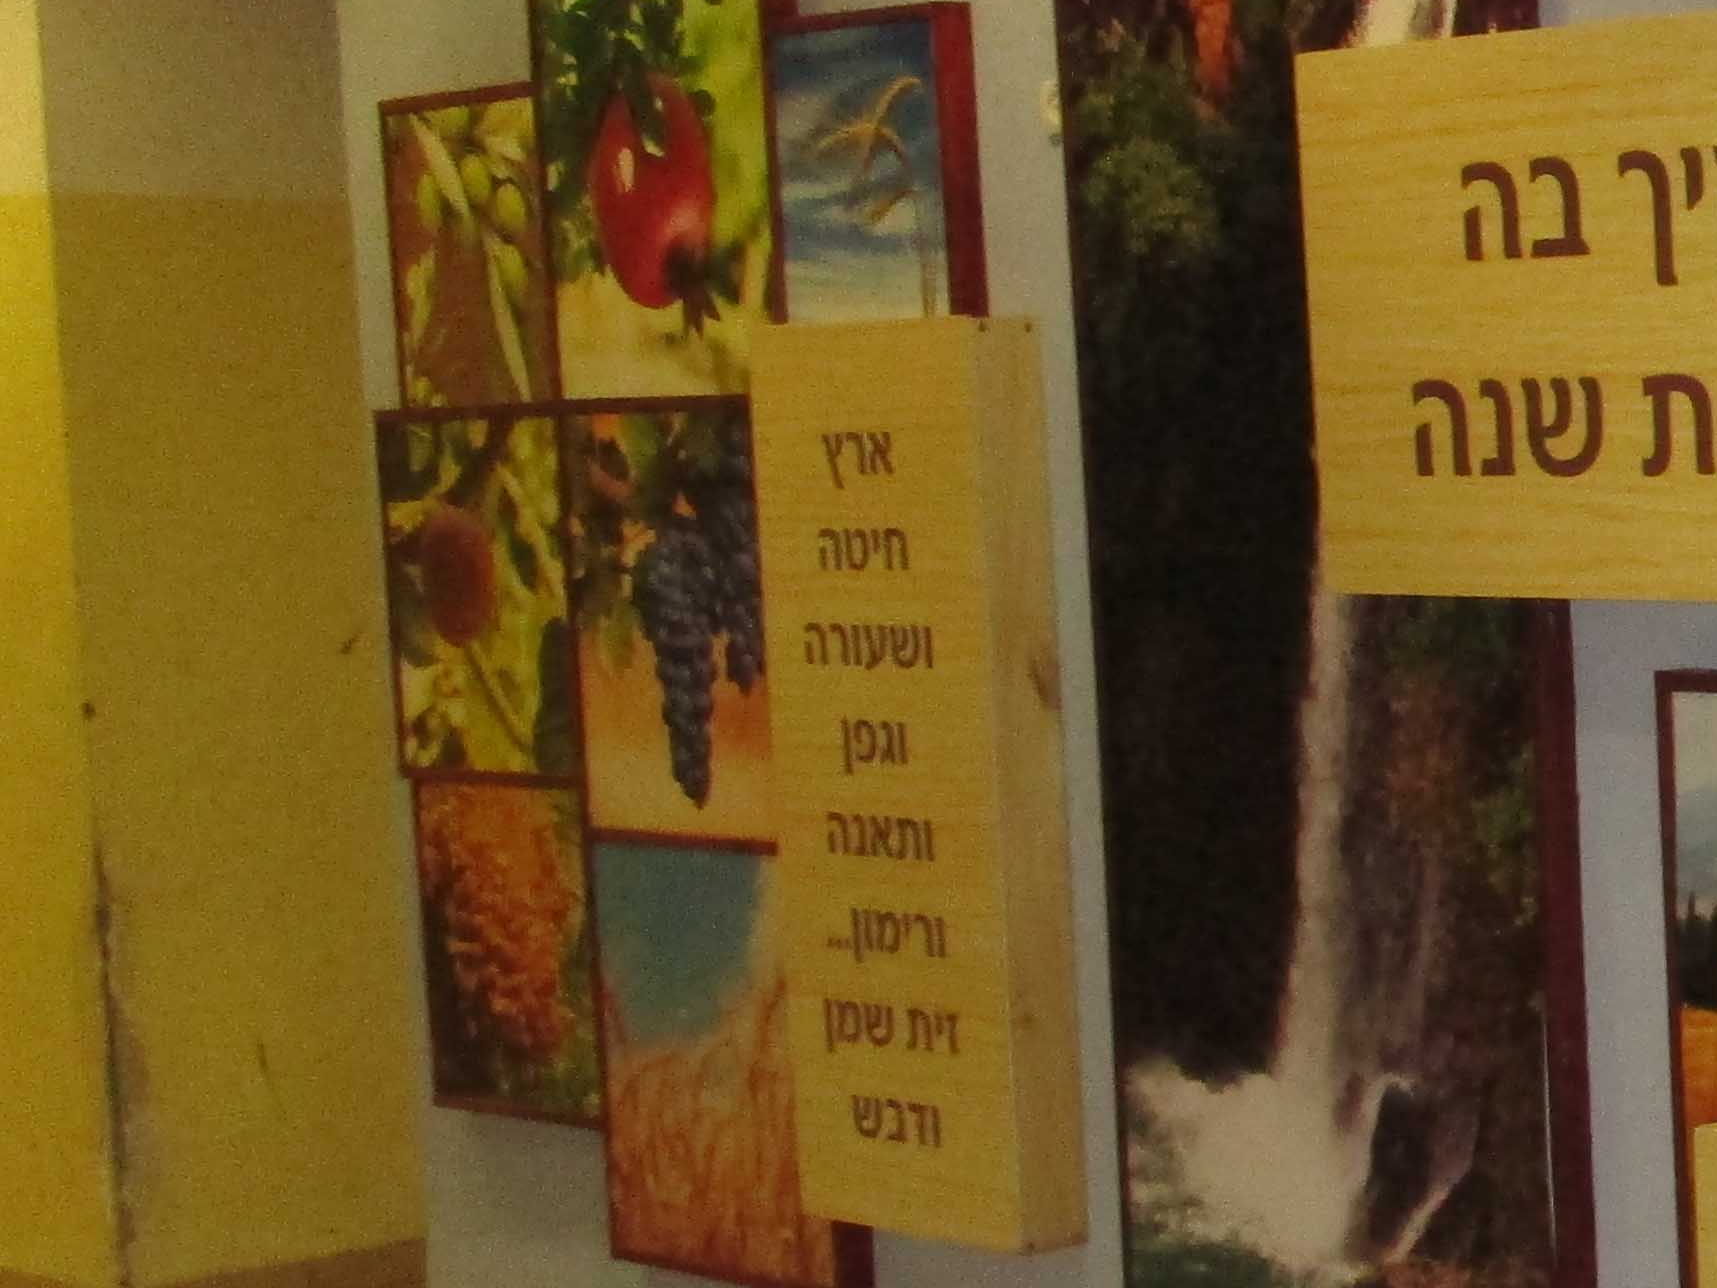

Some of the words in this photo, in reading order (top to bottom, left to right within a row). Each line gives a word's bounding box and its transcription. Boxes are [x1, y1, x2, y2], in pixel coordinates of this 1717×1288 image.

[1459, 155, 1592, 263] בה
[1412, 368, 1605, 482] שנה
[822, 430, 895, 490] ארץ
[818, 528, 909, 572] חיטה
[803, 621, 934, 670] ושעורה
[840, 715, 908, 774] וגפן
[826, 811, 935, 861] ותאנה
[824, 998, 895, 1053] שמן
[906, 1007, 960, 1054] זית
[852, 1094, 941, 1148] ודבש
